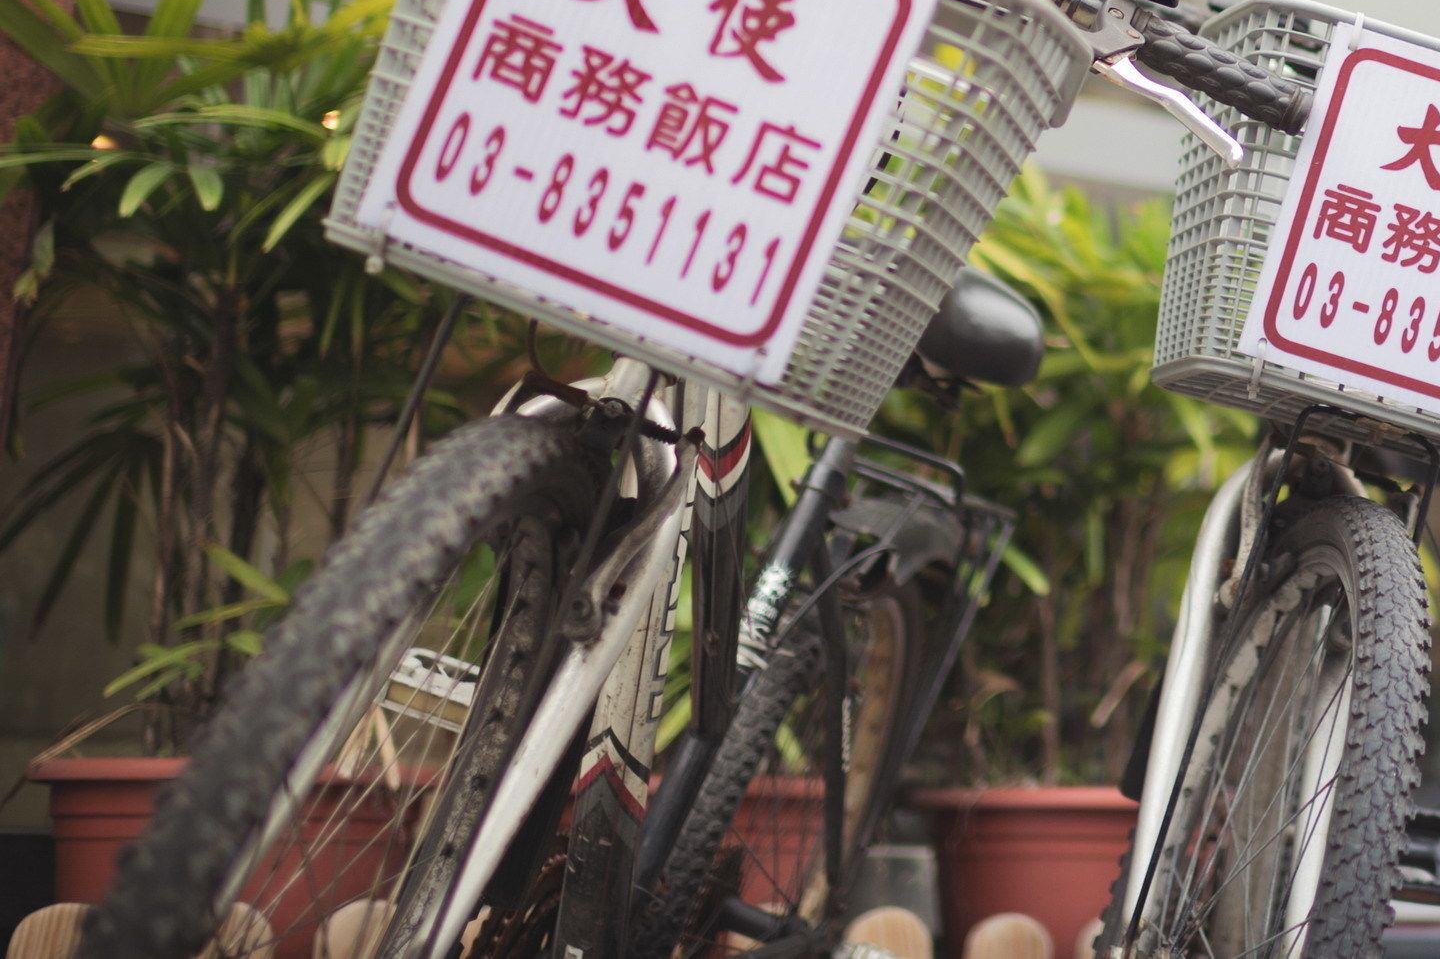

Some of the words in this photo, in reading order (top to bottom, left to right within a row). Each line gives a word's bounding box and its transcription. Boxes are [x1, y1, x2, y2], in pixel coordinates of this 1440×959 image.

[471, 14, 823, 206] 商務飯店
[434, 112, 783, 308] 03-8351131
